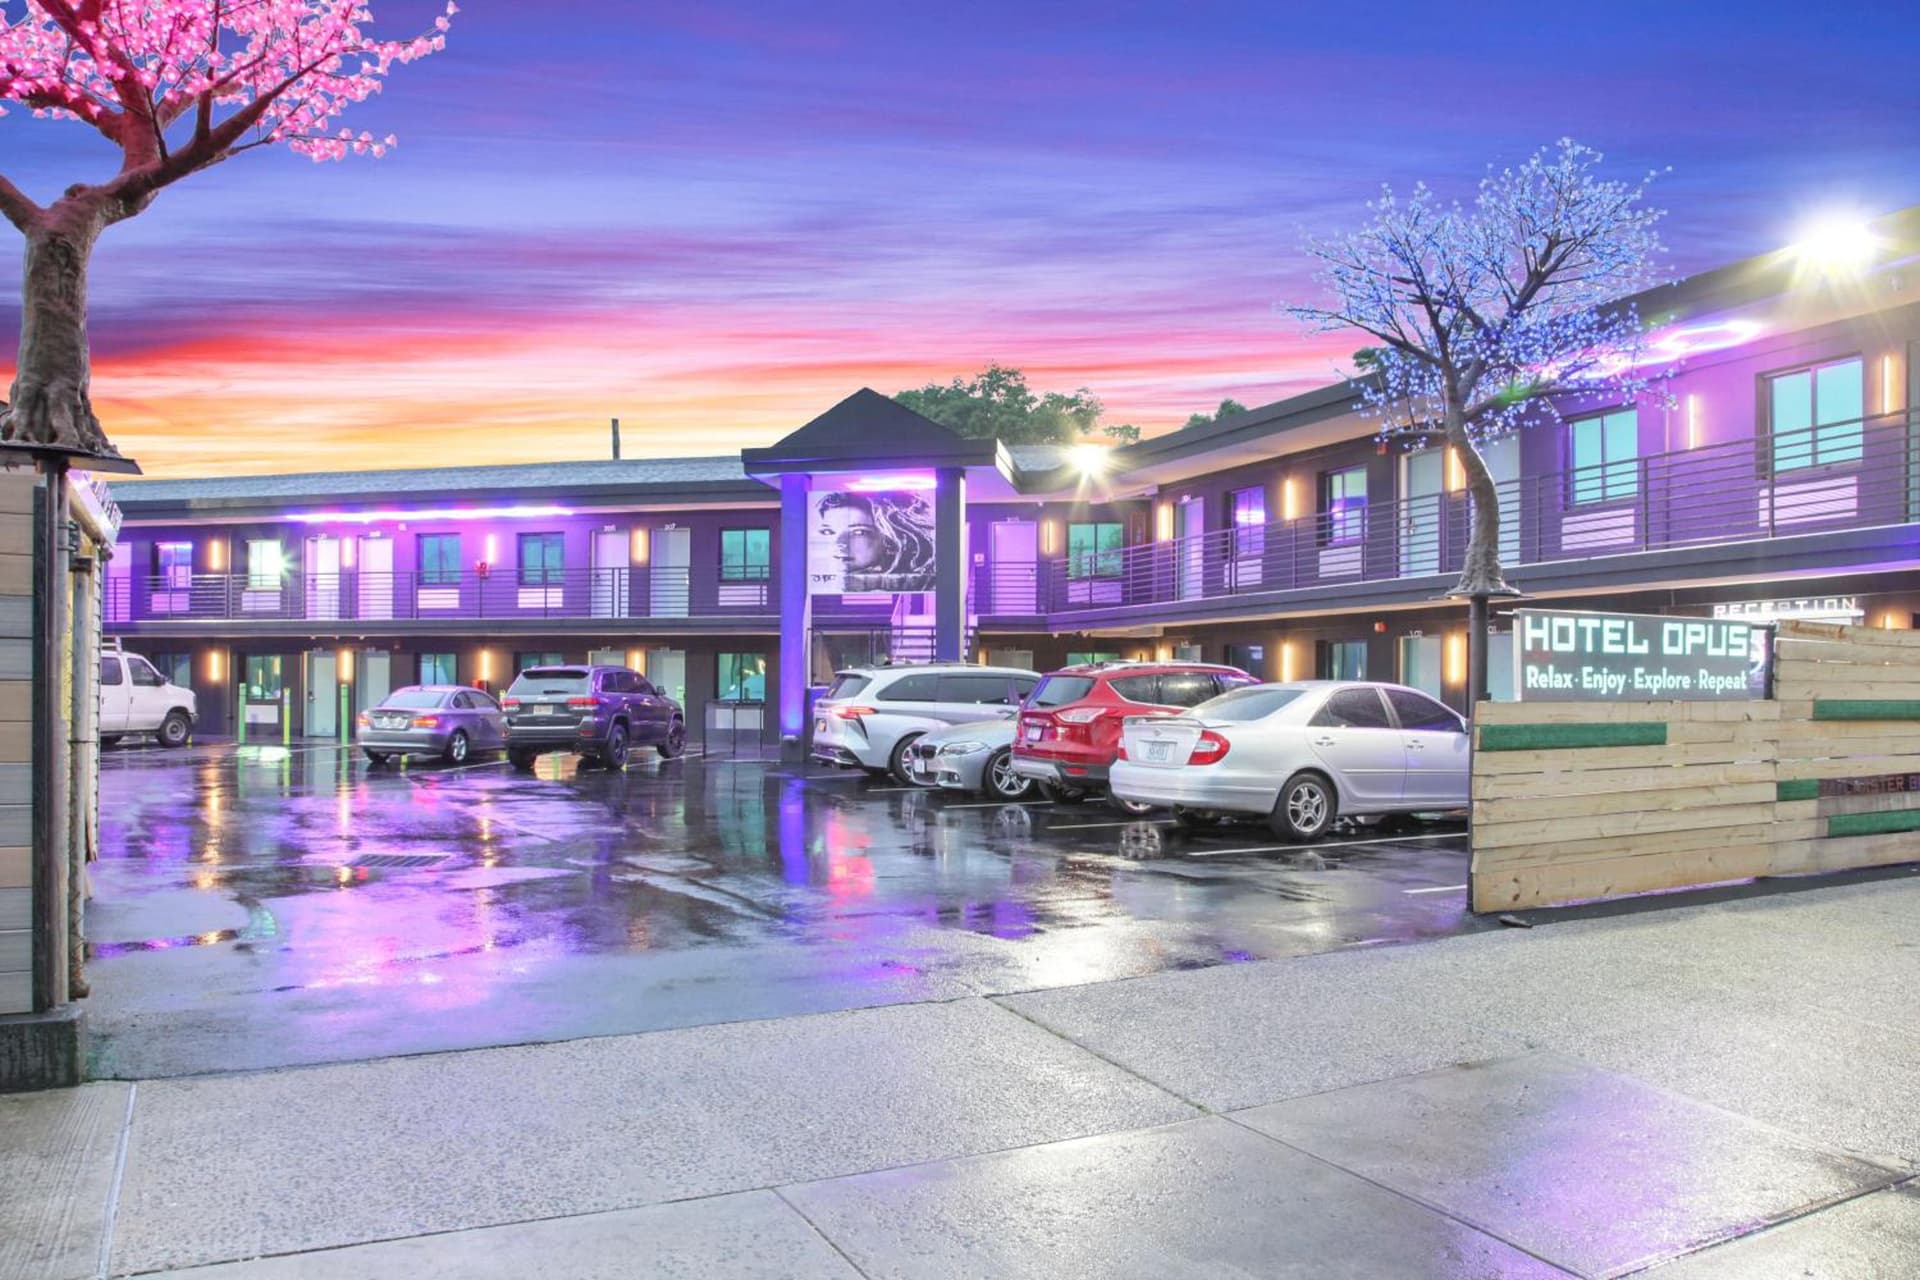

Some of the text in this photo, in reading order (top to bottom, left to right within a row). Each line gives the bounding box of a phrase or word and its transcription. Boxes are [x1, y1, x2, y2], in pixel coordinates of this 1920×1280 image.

[1713, 597, 1856, 619] RECEPTION
[1525, 616, 1748, 657] HOTEL OPUS
[1526, 665, 1748, 695] Relax Enjoy Explore Repeat
